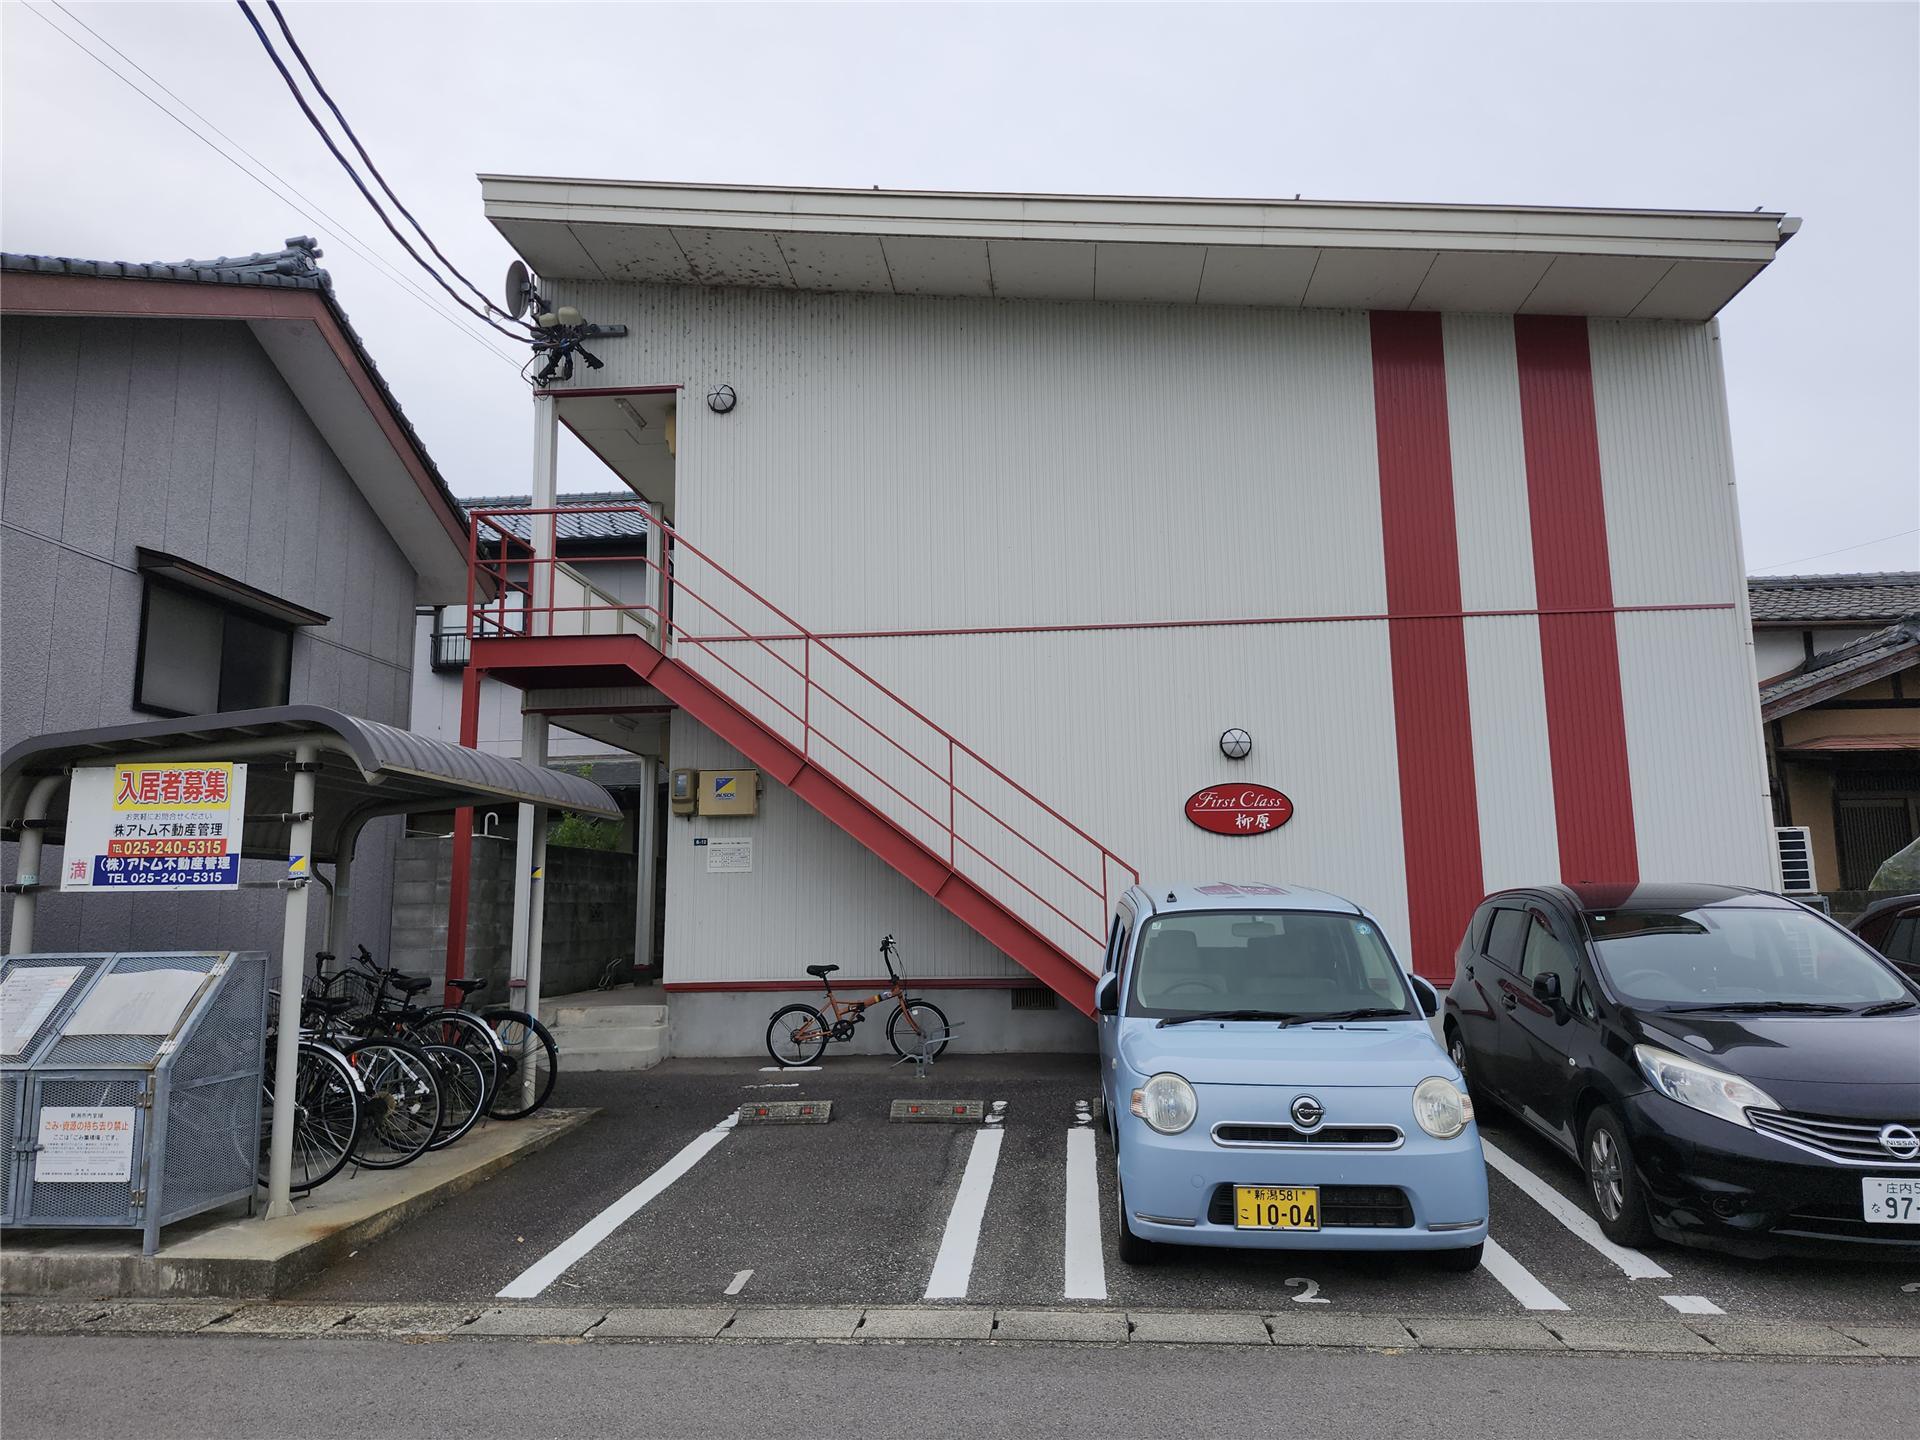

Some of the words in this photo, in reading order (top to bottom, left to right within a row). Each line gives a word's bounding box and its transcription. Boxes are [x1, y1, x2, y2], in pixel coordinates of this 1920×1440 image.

[117, 770, 228, 804] 入居者募集
[1195, 791, 1236, 807] First
[1240, 791, 1282, 807] Class
[125, 812, 213, 821] お気軽にお問合せください
[1235, 813, 1270, 829] 柳原
[113, 823, 223, 837] 株アトム不動産管理
[124, 840, 221, 855] 025-240-5315
[70, 859, 87, 880] 満
[107, 873, 127, 883] TEL
[131, 872, 222, 883] 025-240-5315
[1886, 1139, 1919, 1147] NISSAN
[1240, 1208, 1249, 1220] こ
[1256, 1204, 1316, 1227] 10-04
[1871, 1202, 1881, 1214] な
[1284, 1277, 1331, 1304] 2
